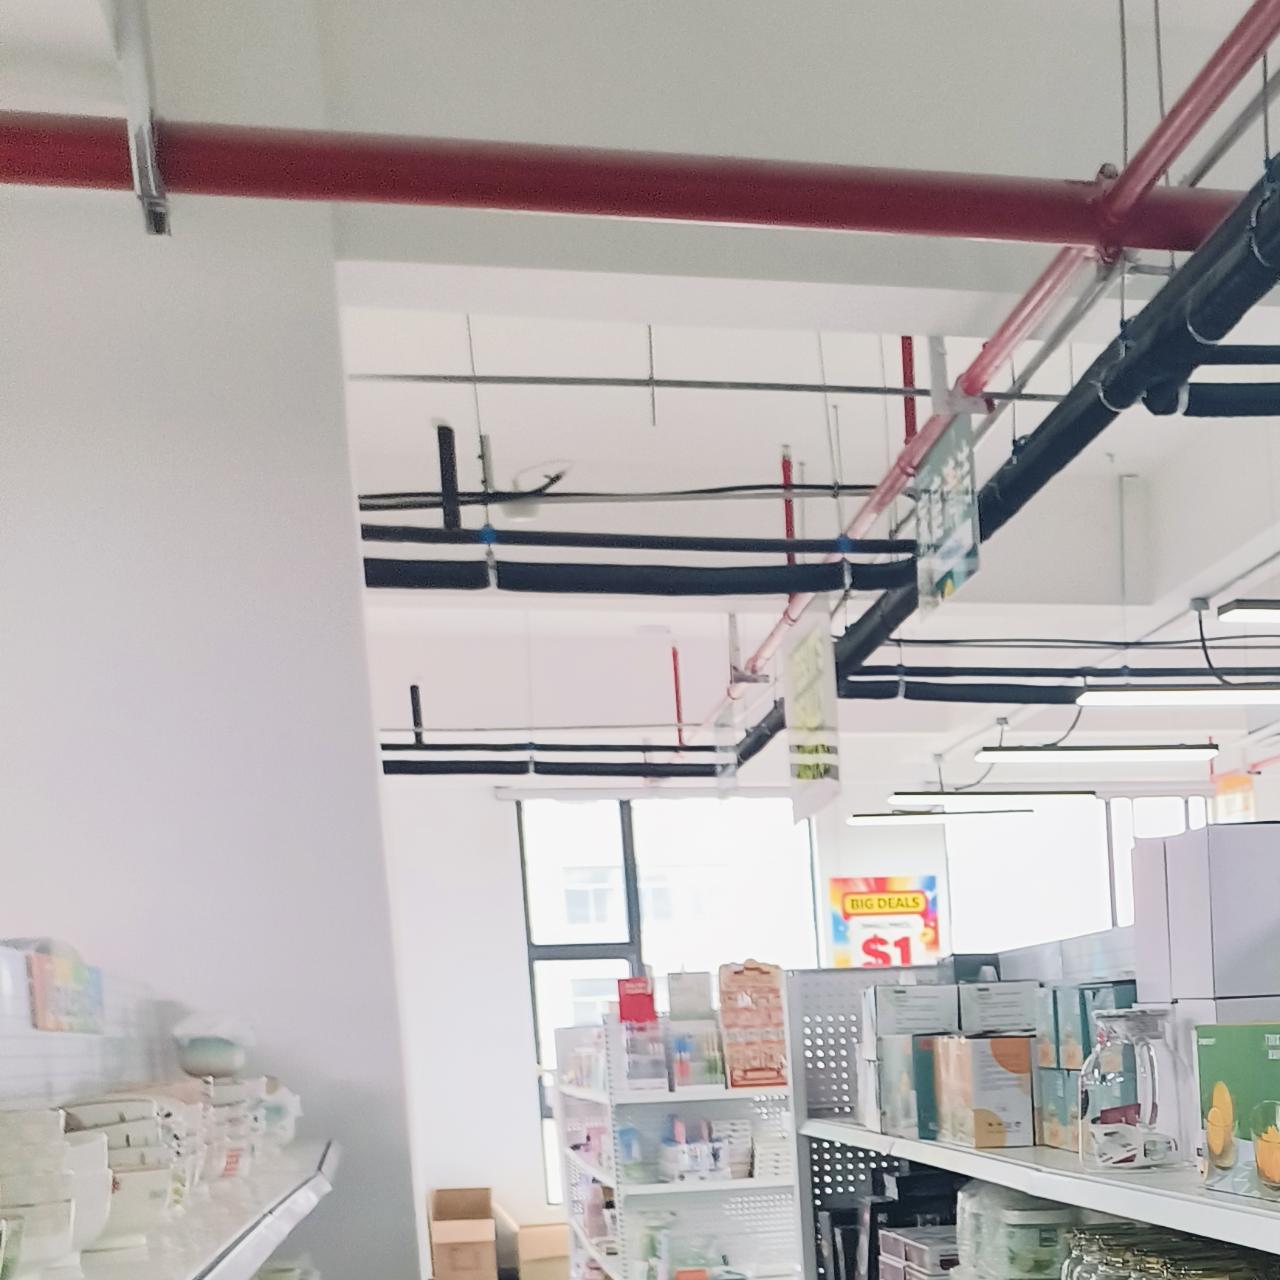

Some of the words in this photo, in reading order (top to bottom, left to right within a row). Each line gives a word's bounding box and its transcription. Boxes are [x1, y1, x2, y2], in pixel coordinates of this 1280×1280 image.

[850, 898, 873, 910] BIG
[877, 897, 920, 909] DEALS
[862, 934, 912, 968] $1
